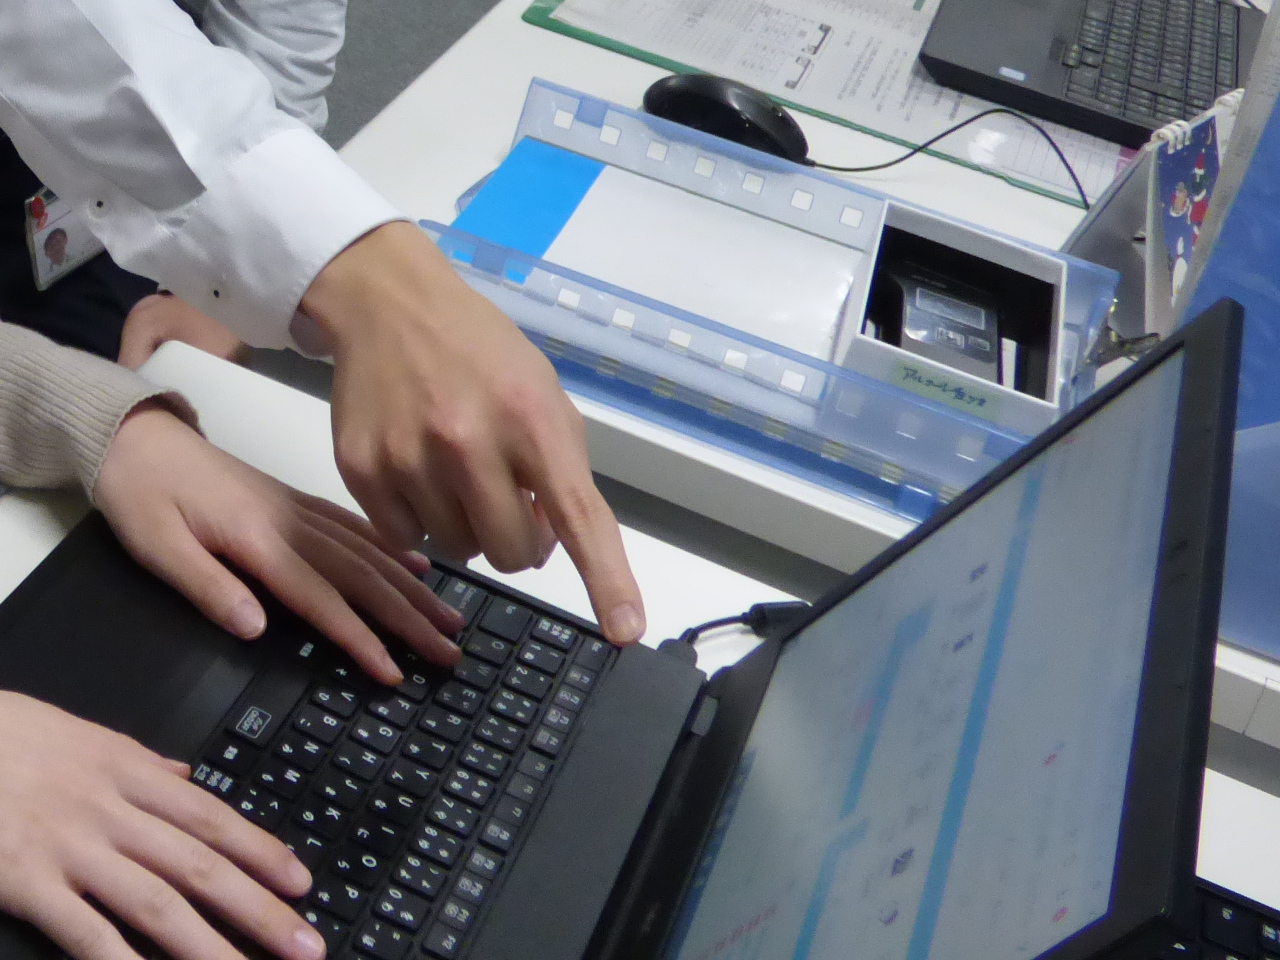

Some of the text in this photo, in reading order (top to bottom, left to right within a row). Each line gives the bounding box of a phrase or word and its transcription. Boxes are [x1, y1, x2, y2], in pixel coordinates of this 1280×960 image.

[516, 666, 528, 675] 2
[341, 692, 354, 702] V
[462, 689, 477, 699] E
[502, 691, 514, 700] 3
[398, 700, 410, 710] F
[323, 715, 337, 726] B
[447, 715, 462, 725] R
[488, 717, 498, 725] 4
[379, 726, 393, 737] G
[304, 741, 319, 753] N
[432, 742, 446, 752] T
[472, 743, 485, 752] 5
[362, 751, 377, 764] H
[284, 769, 301, 782] M
[416, 770, 430, 780] Y
[457, 771, 469, 780] 6
[345, 779, 358, 790] J
[398, 796, 413, 807] U
[442, 798, 454, 808] 7
[325, 807, 341, 820] K
[425, 826, 438, 836] 8
[307, 837, 322, 846] L
[407, 856, 421, 867] 9
[345, 885, 359, 899] P
[389, 888, 402, 899] 0
